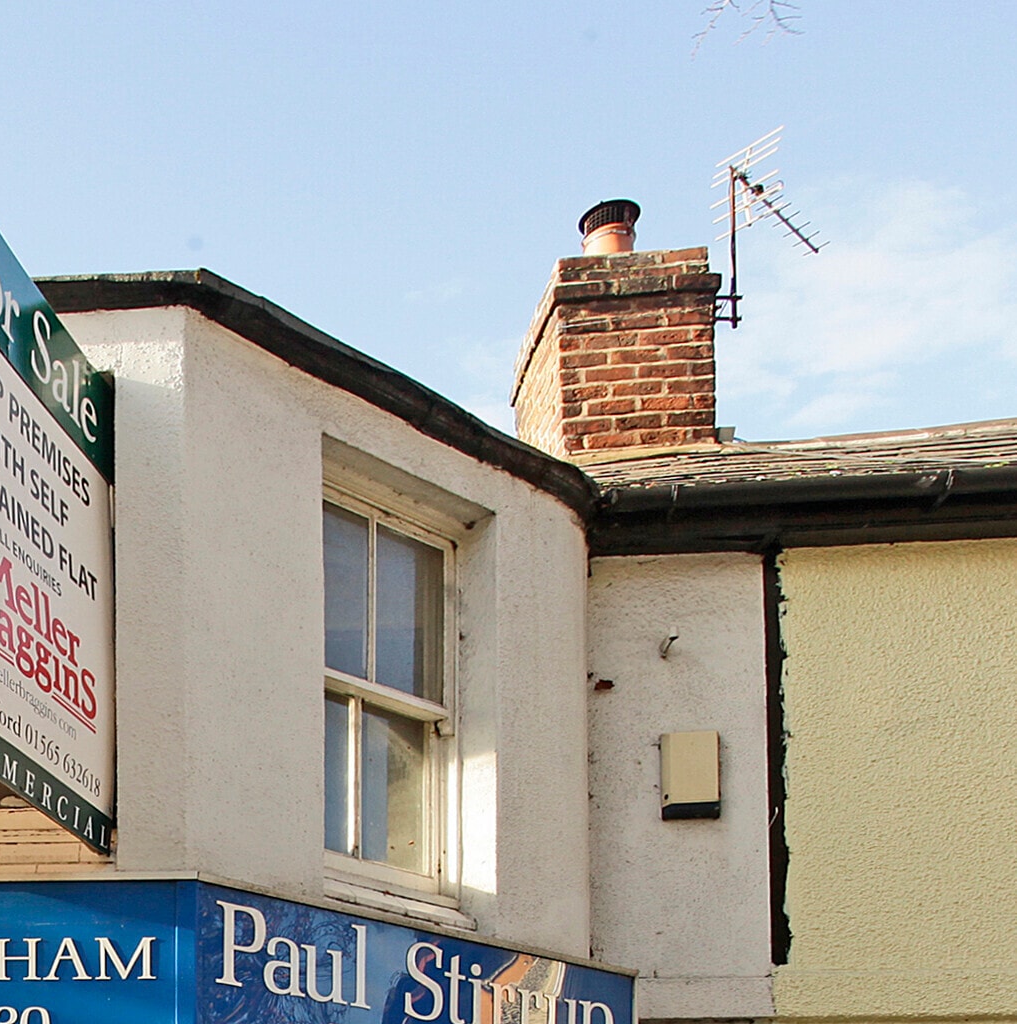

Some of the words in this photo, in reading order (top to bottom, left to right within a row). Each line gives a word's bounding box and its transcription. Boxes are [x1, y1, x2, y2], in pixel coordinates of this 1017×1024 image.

[31, 310, 98, 442] Sale
[9, 393, 90, 507] PREMISES
[30, 468, 69, 527] SELF
[12, 542, 63, 597] ENQUIRIES
[58, 542, 98, 601] FLAT
[25, 723, 61, 766] 01565
[63, 753, 101, 798] 632618
[214, 899, 371, 1010] Paul
